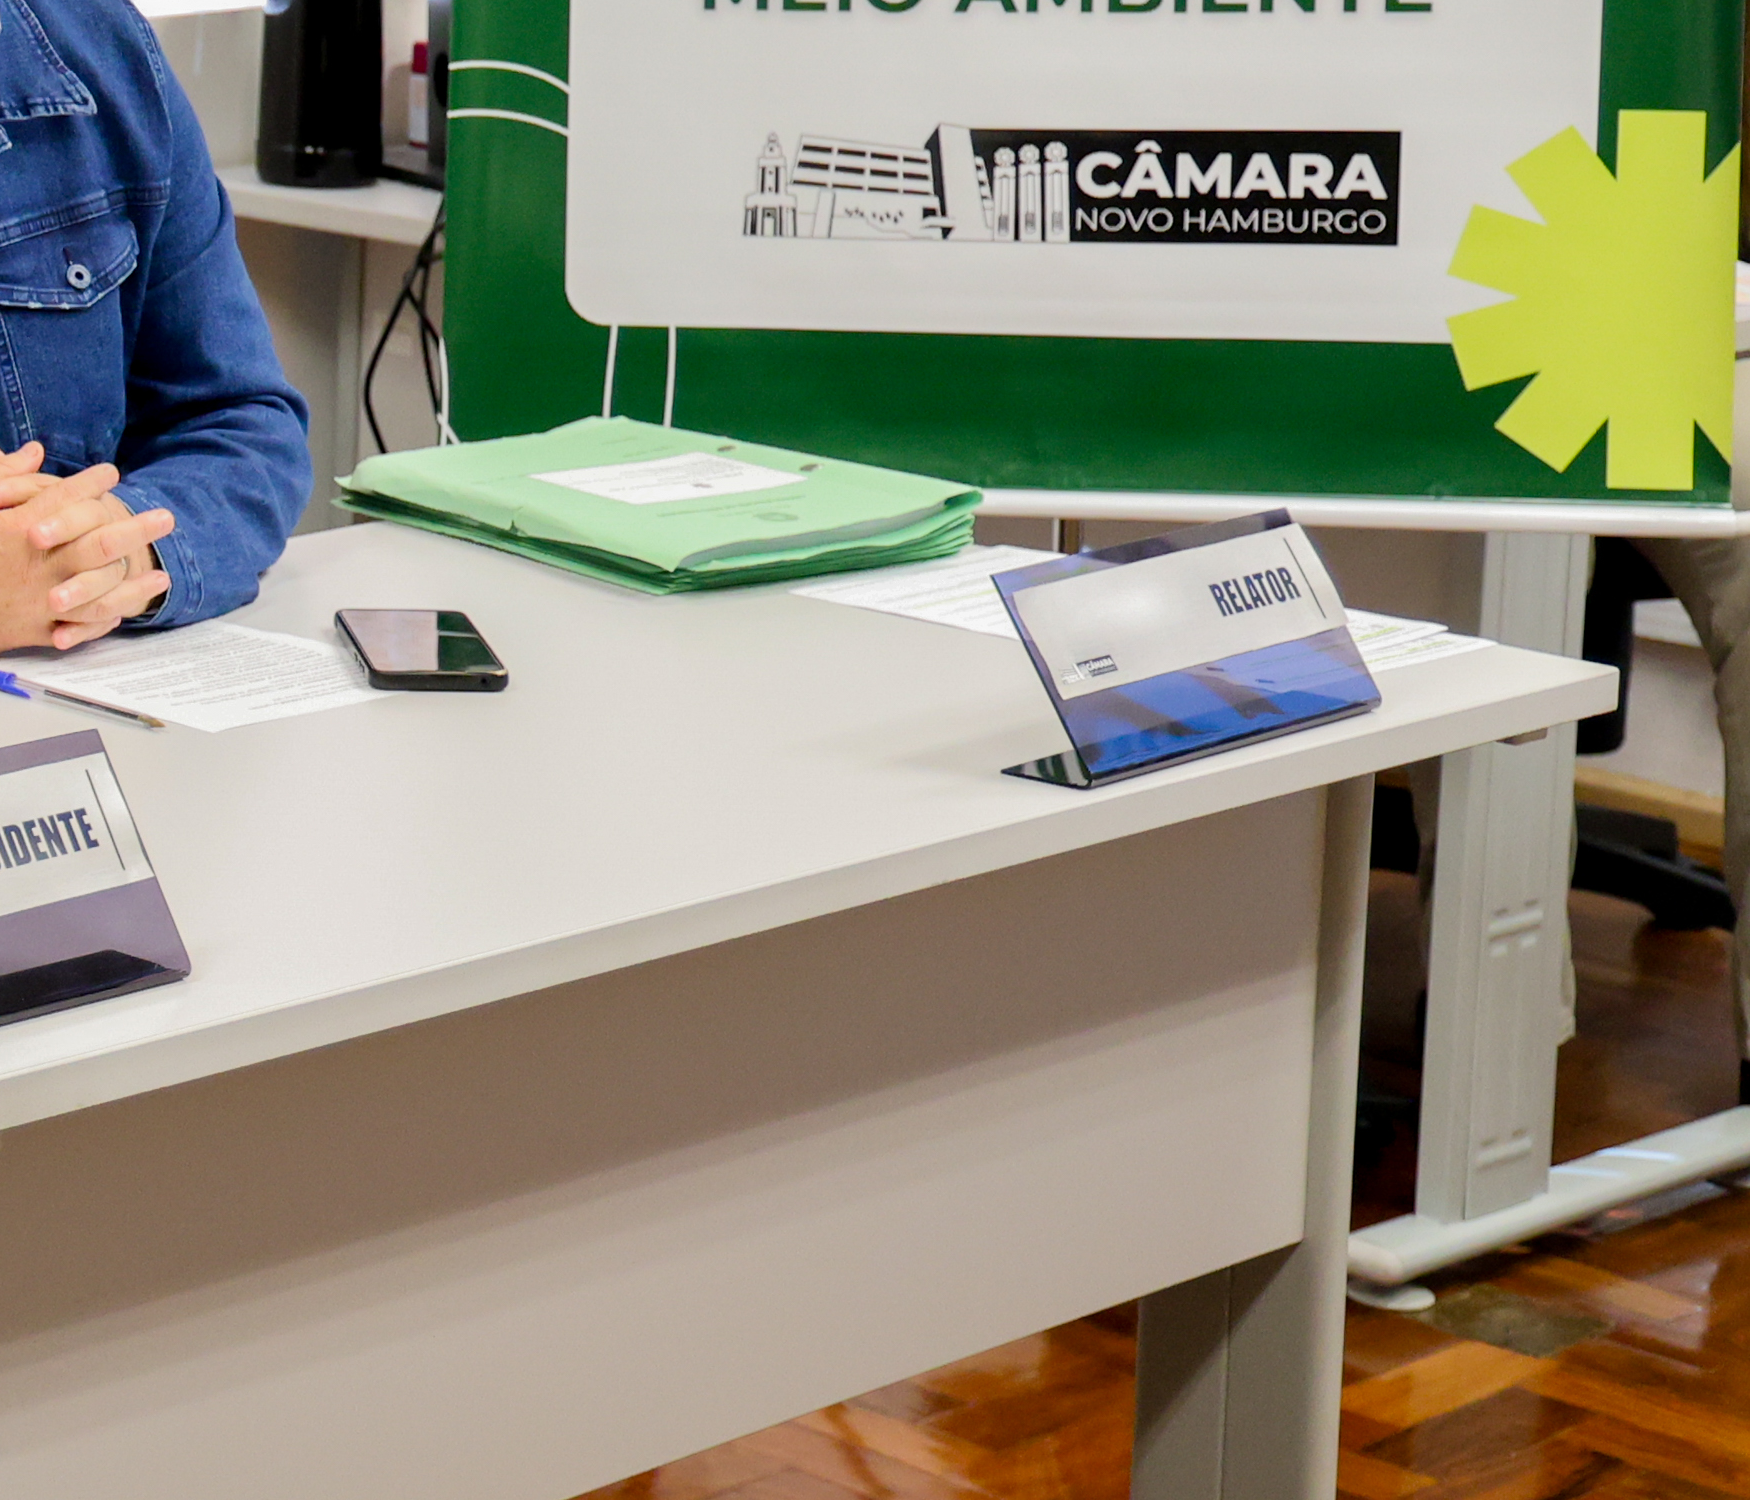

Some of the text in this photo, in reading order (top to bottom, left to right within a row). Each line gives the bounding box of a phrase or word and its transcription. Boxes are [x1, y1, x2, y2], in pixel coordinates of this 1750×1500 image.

[1074, 139, 1387, 202] CÂMARA
[1074, 208, 1387, 235] NOVO HAMBURGO
[1208, 567, 1302, 617] RELATOR
